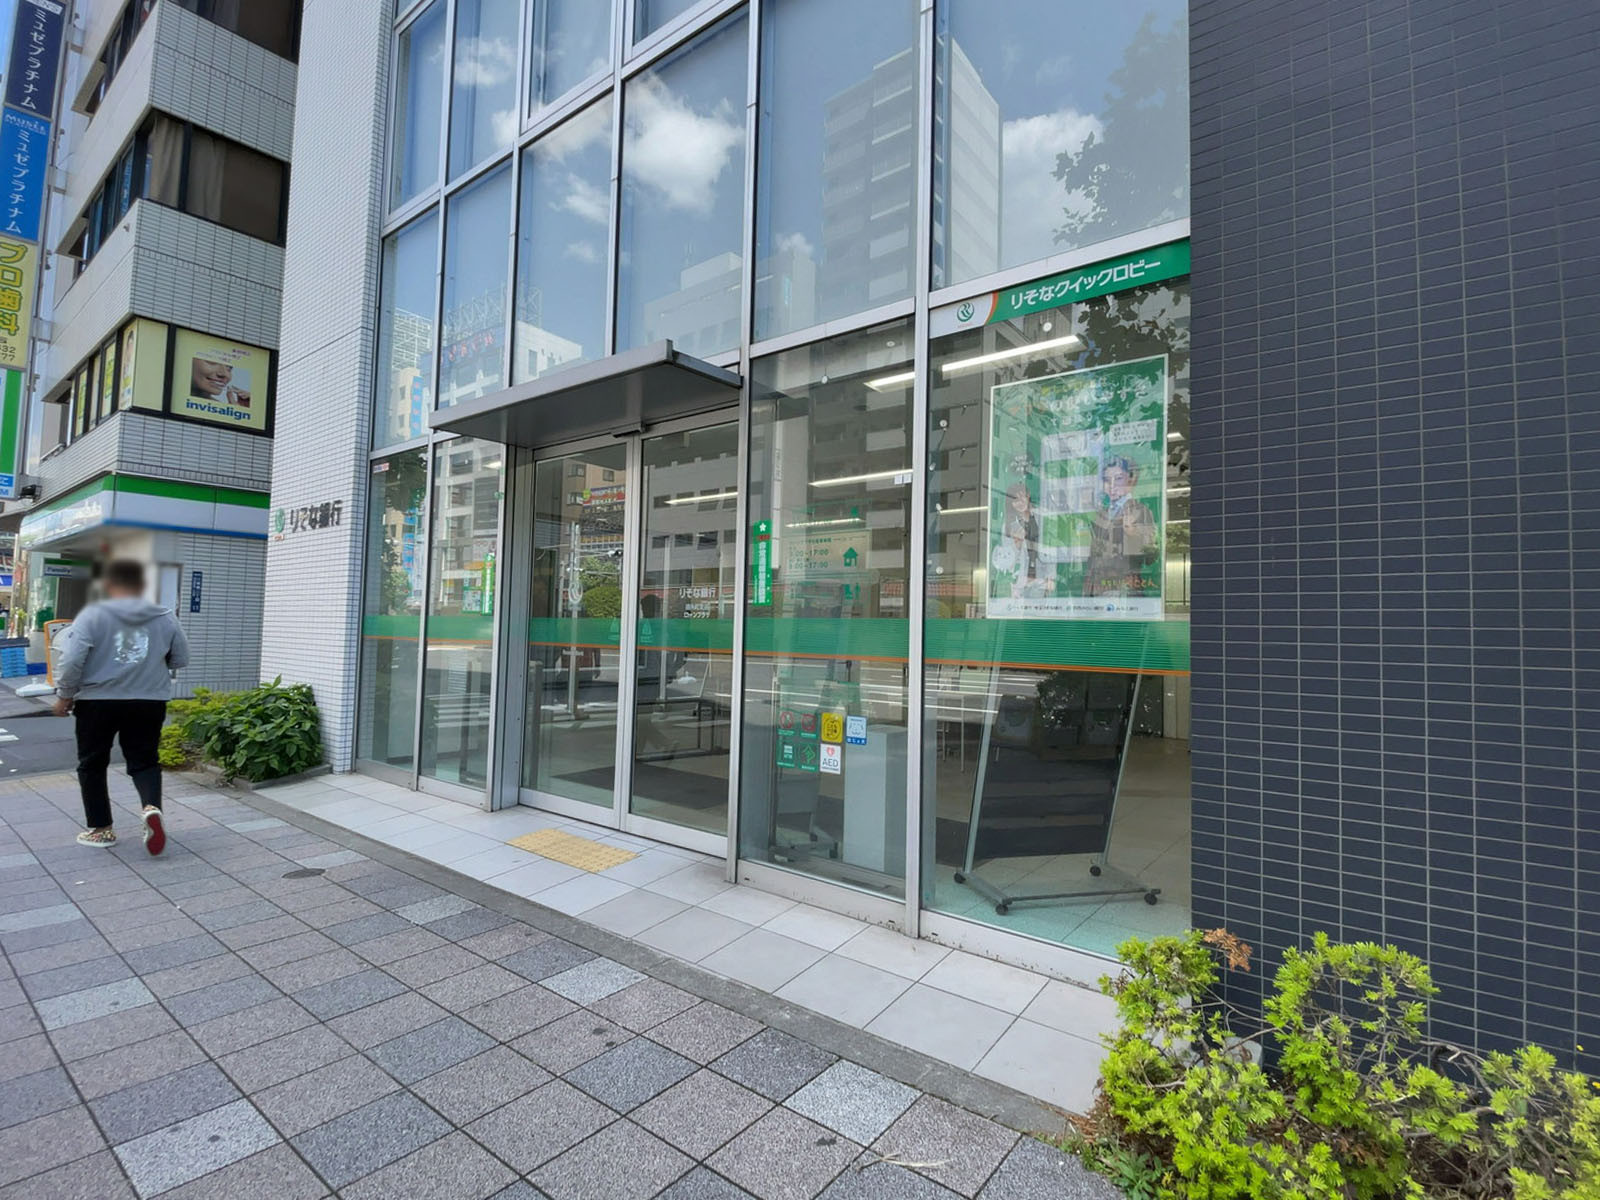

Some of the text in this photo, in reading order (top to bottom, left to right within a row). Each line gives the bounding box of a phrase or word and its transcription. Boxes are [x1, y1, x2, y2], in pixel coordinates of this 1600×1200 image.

[20, 8, 47, 110] ミュゼプラチナム
[5, 129, 30, 234] ミュゼプラチナム
[1010, 258, 1161, 310] りそなクイックロビー
[185, 399, 251, 420] invisalign
[679, 586, 716, 599] りそな銀行
[822, 757, 839, 768] AED
